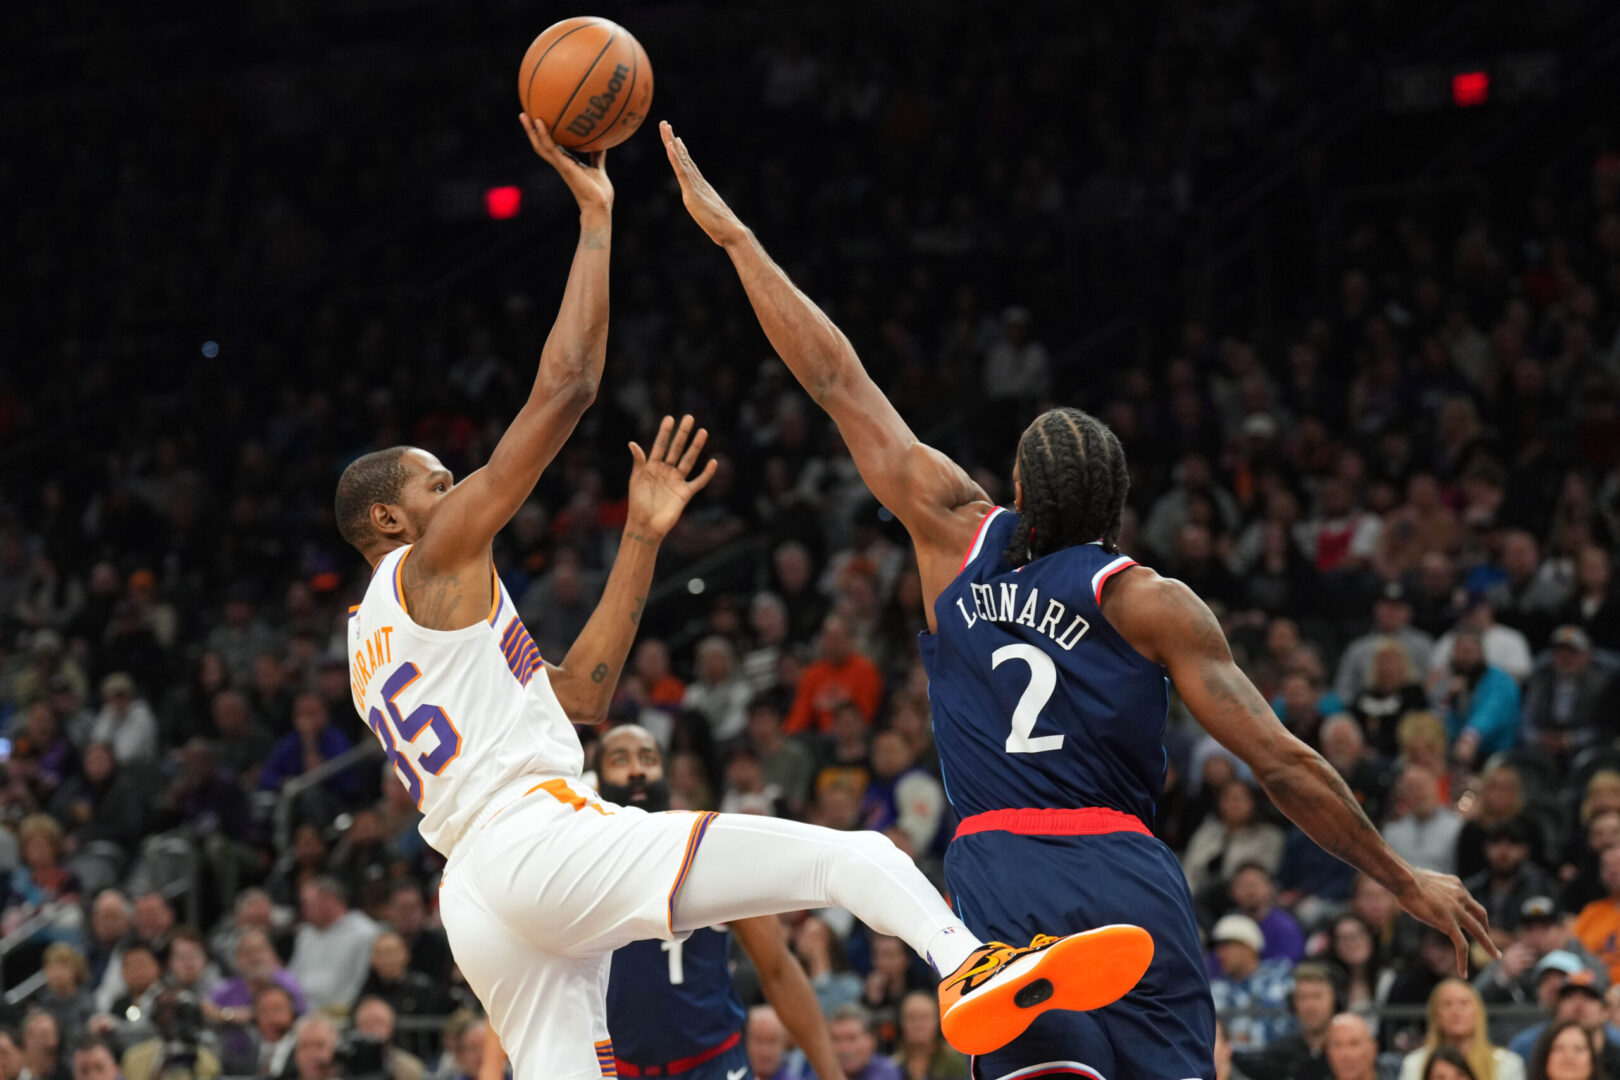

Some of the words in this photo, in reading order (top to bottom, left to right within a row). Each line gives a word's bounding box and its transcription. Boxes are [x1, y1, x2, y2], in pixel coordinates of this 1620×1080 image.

[566, 64, 630, 137] Wilson
[957, 583, 1090, 651] LEONARD
[352, 626, 393, 712] DURANT
[992, 643, 1065, 753] 2
[661, 941, 684, 985] 1
